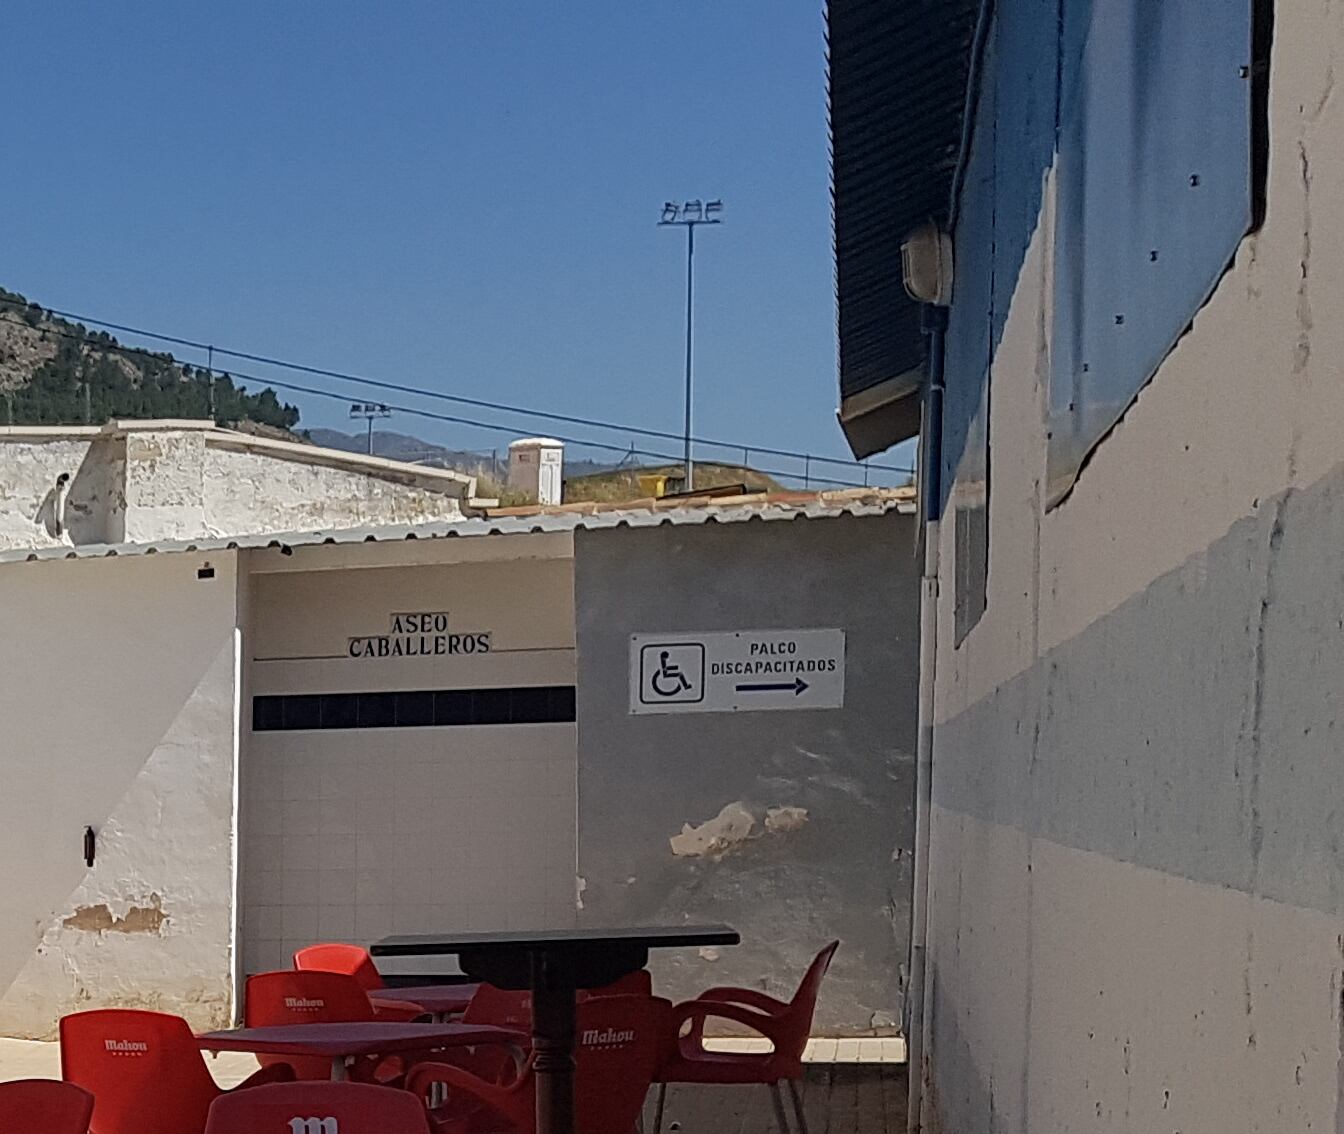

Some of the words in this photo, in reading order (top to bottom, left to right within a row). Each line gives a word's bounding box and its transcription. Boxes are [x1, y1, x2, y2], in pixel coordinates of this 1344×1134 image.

[391, 614, 447, 634] ASEO
[349, 634, 490, 658] CABALLEROS
[750, 641, 797, 656] PALCO
[712, 659, 836, 675] DISCAPACITADOS
